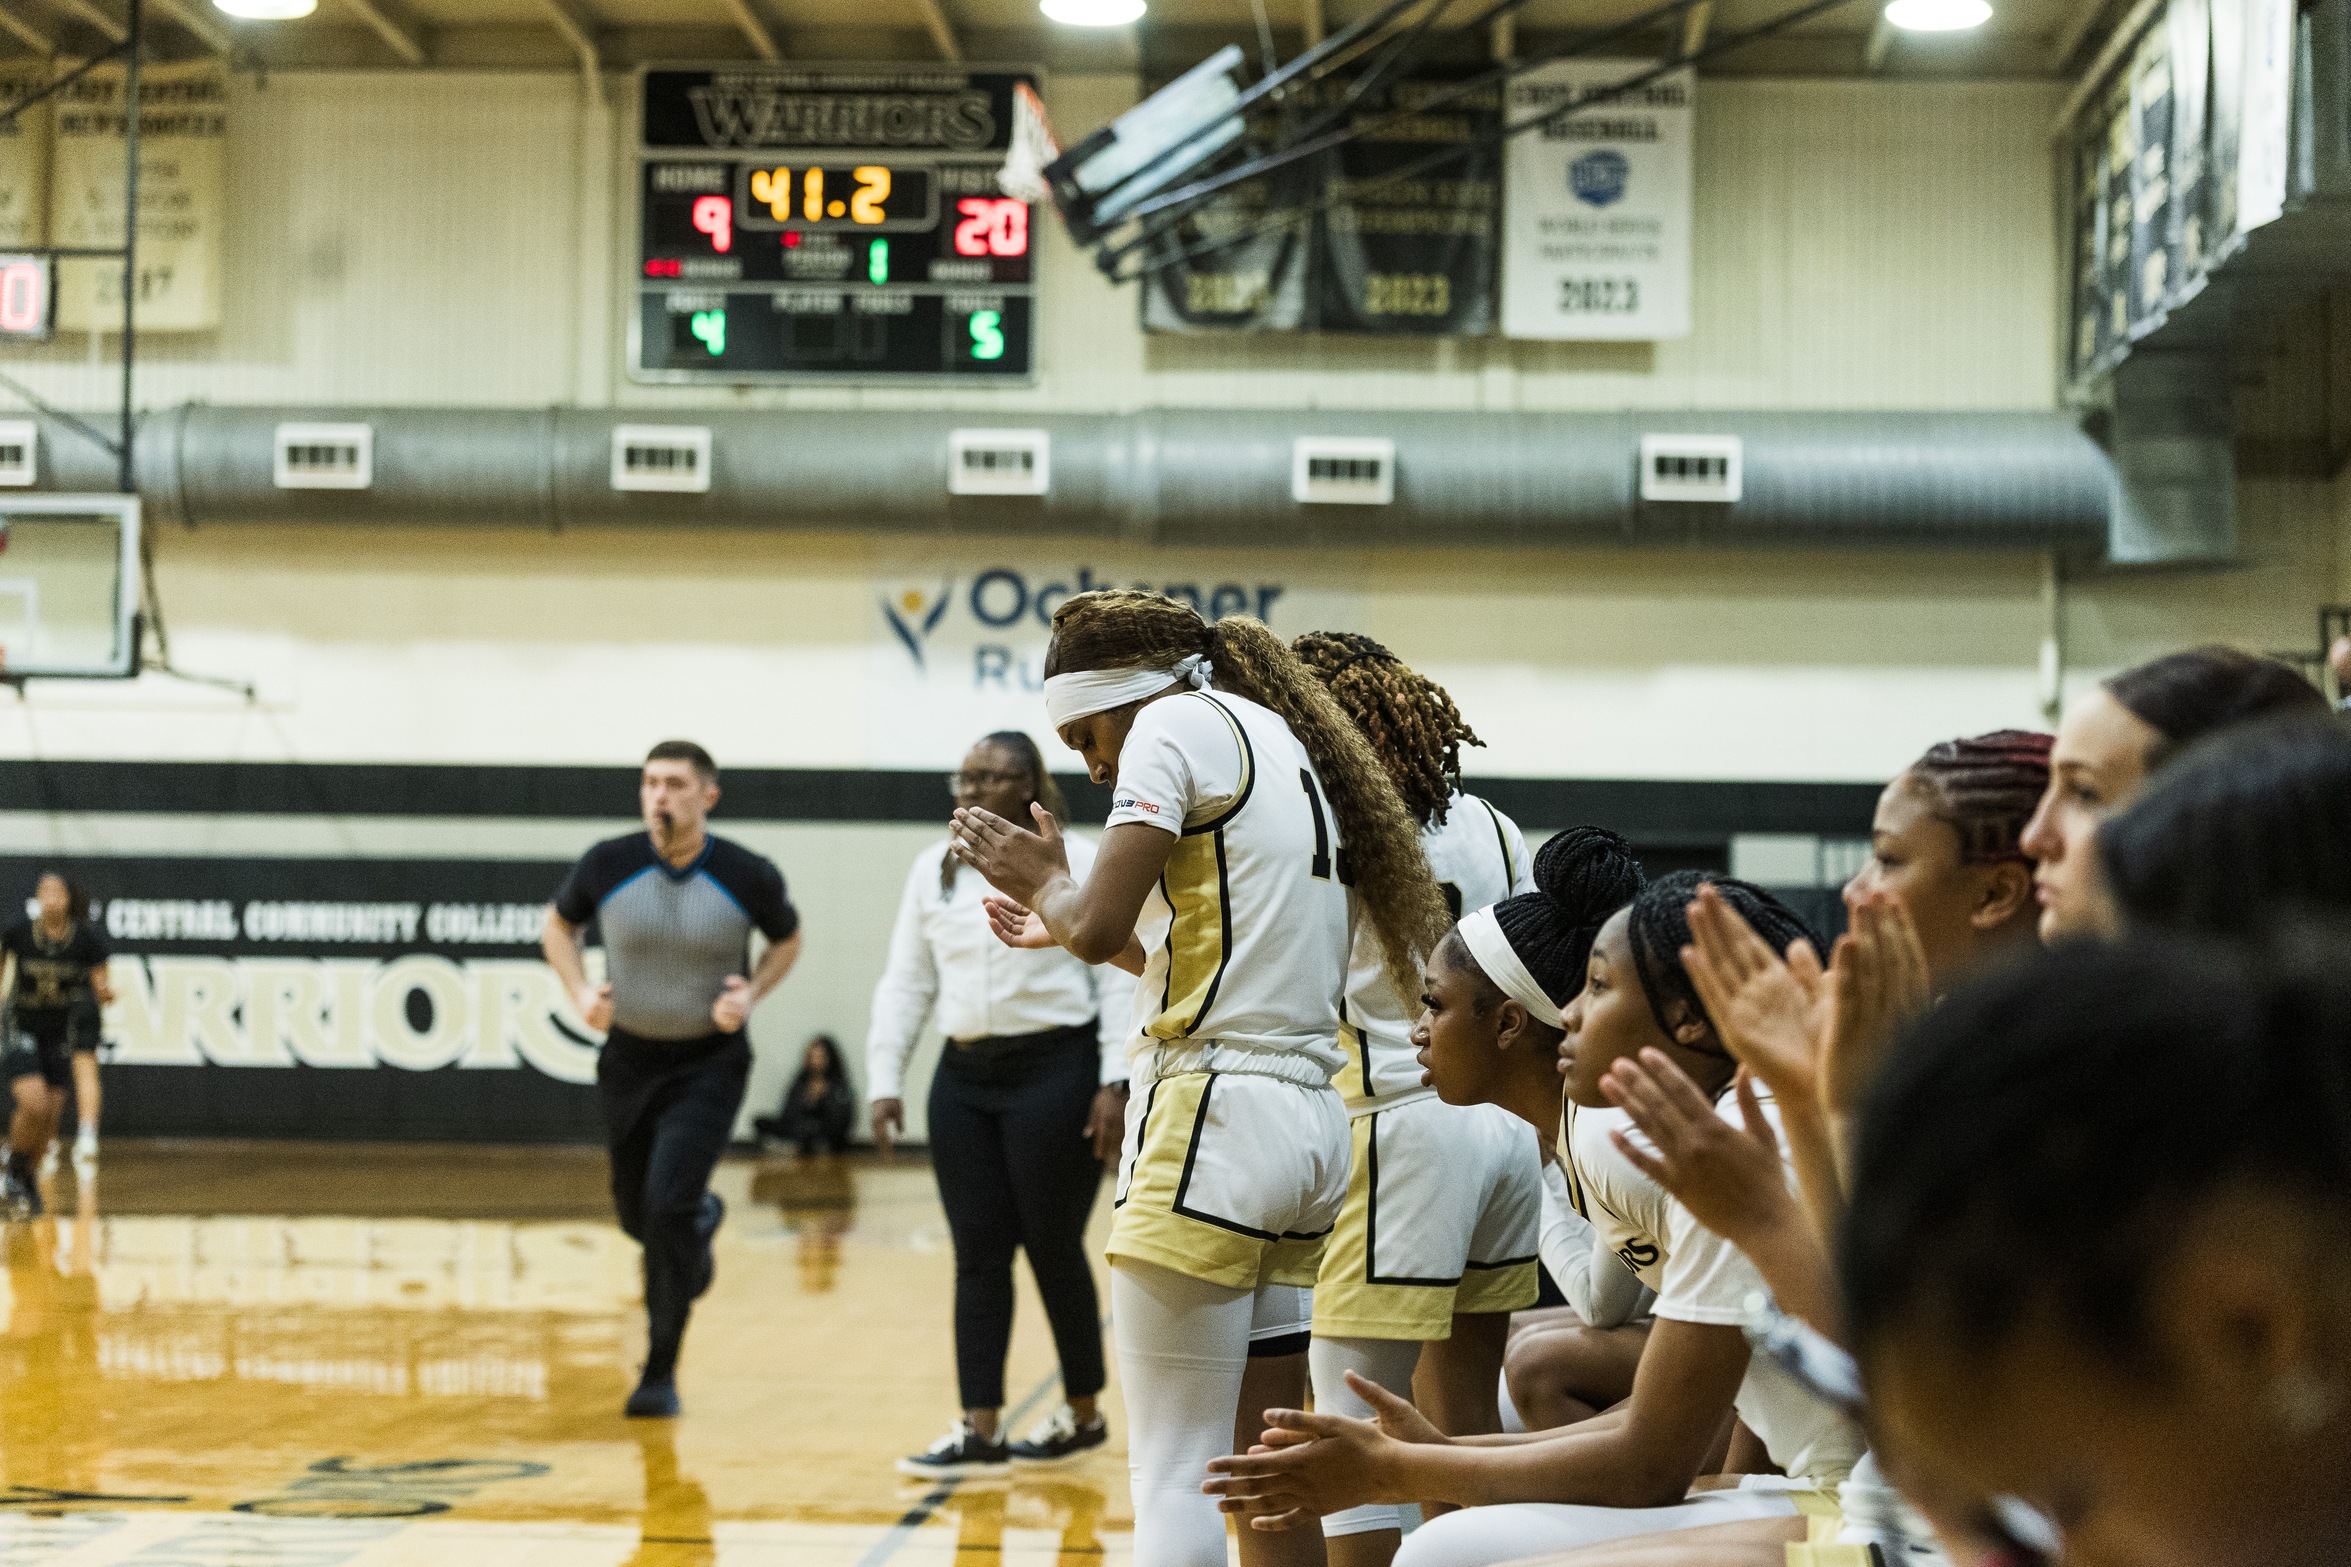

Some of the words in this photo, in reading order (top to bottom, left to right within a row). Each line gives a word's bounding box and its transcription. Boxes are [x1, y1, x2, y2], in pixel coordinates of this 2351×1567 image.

[689, 86, 996, 149] WARRIORS
[692, 195, 732, 254] 9
[751, 166, 892, 225] 41.2
[955, 198, 1029, 257] 20
[869, 237, 889, 285] 1
[691, 308, 726, 356] 4
[969, 309, 1004, 360] 5
[970, 566, 1285, 630] Ocner
[426, 903, 549, 943] COLLEG
